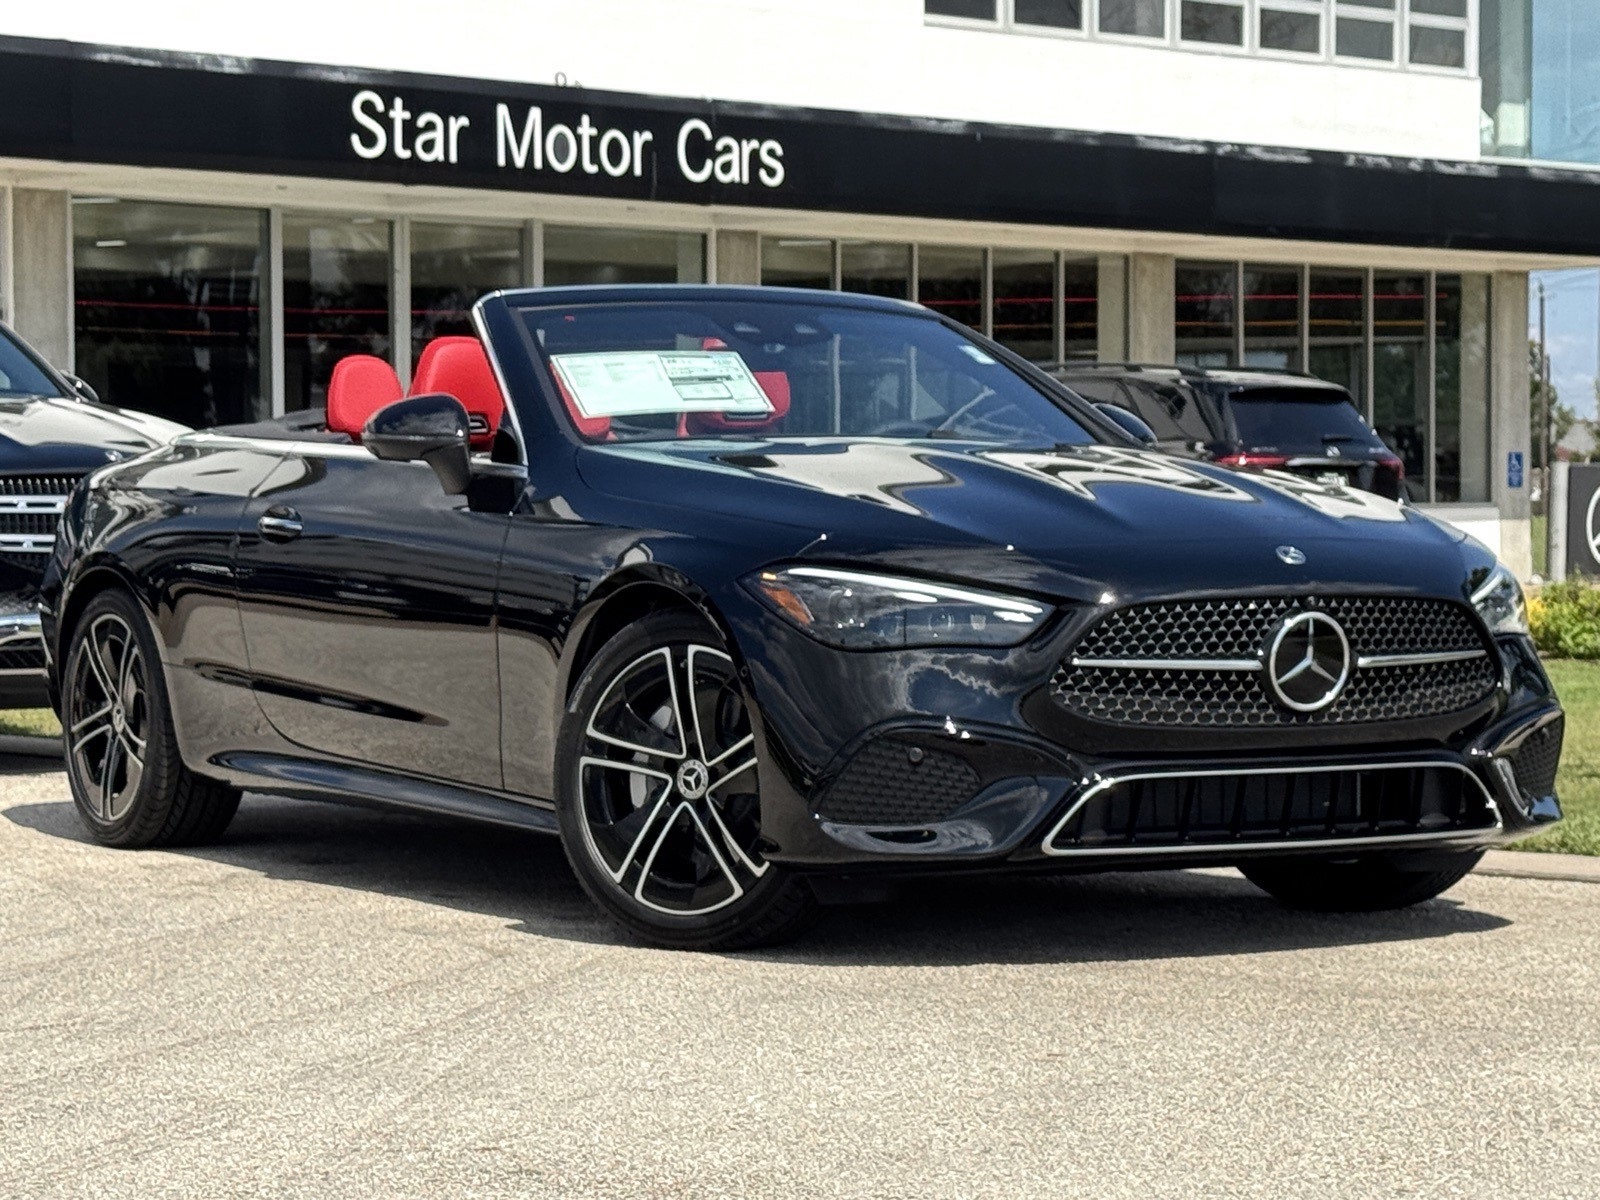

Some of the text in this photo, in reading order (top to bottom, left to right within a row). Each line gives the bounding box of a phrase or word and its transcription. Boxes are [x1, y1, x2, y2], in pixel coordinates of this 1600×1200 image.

[350, 90, 786, 188] Star Motor Cars
